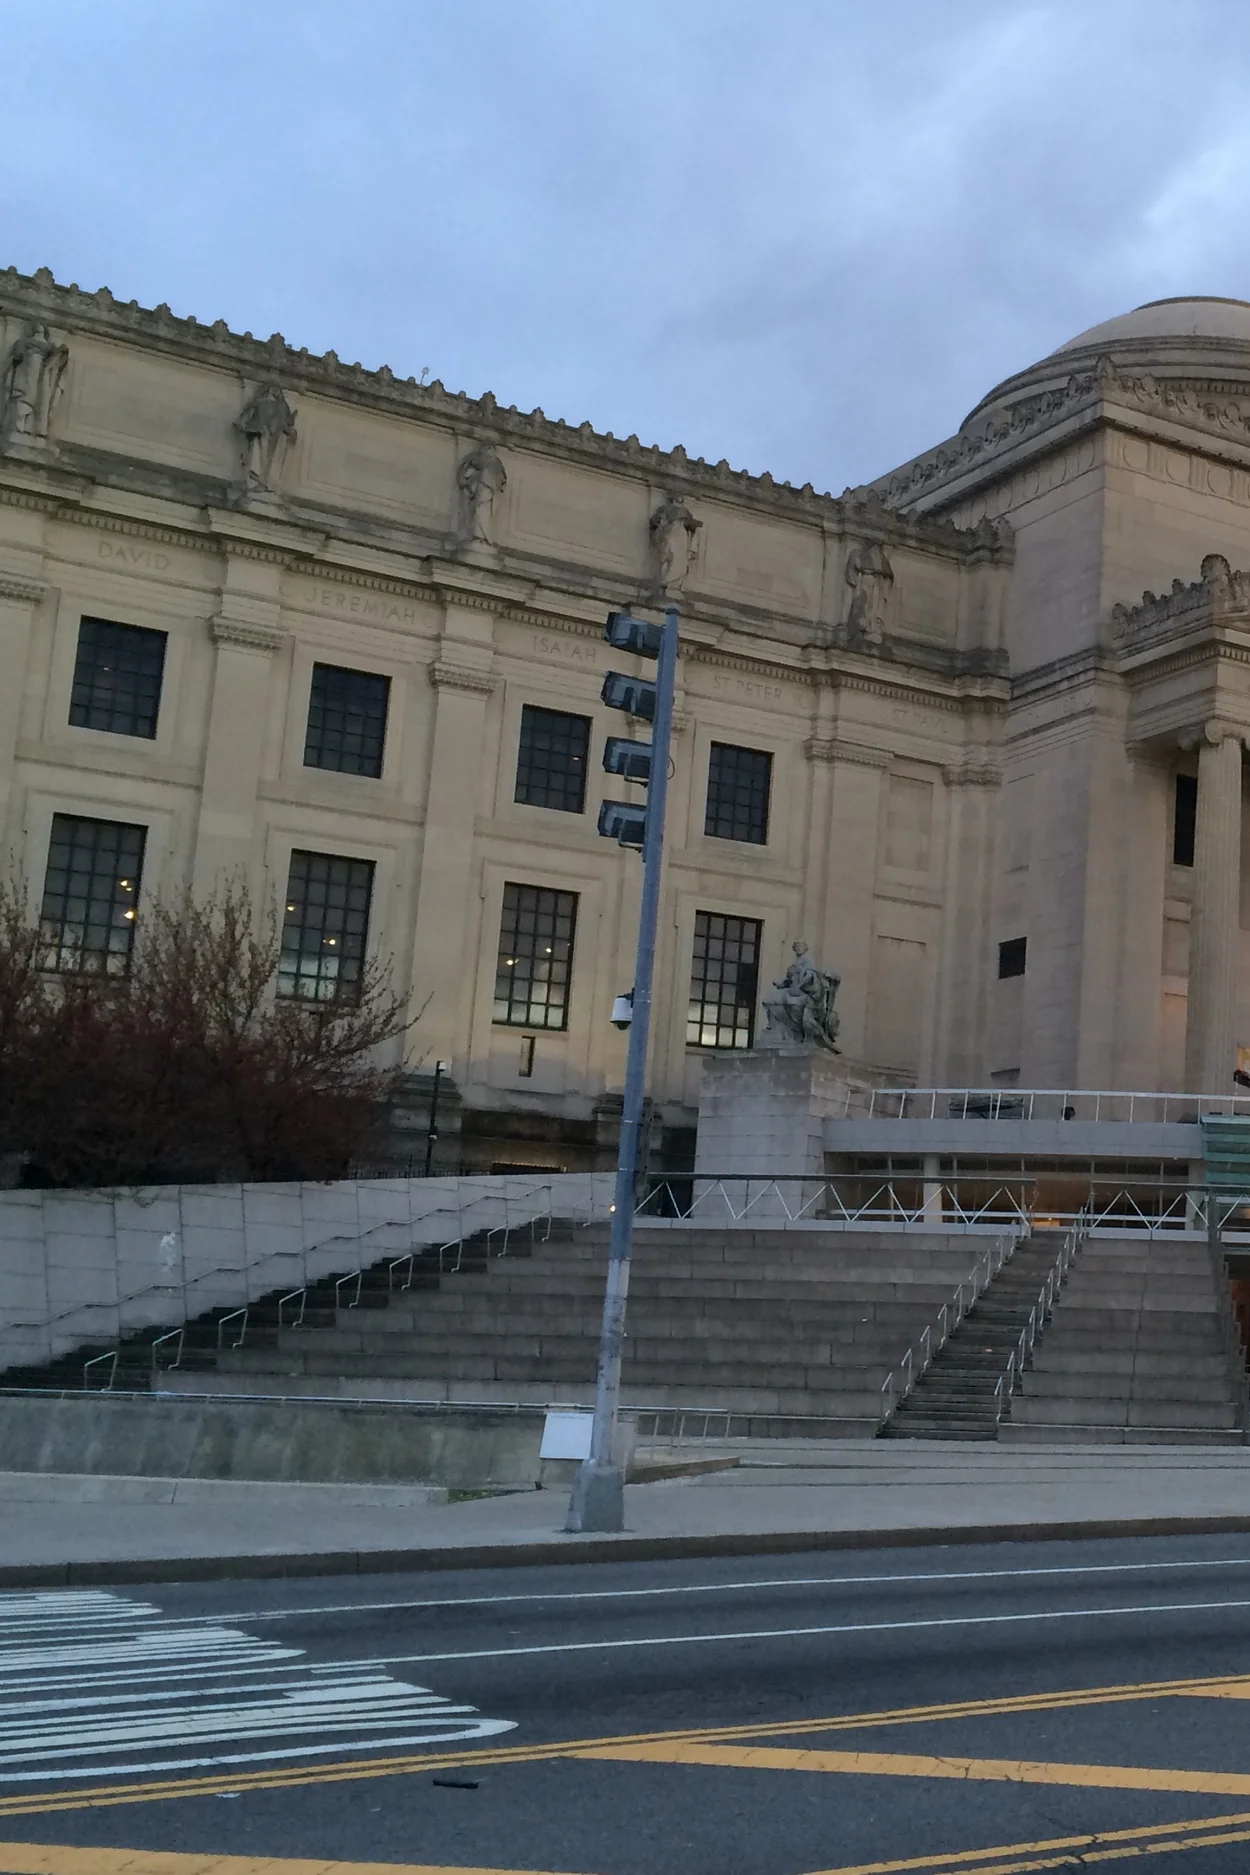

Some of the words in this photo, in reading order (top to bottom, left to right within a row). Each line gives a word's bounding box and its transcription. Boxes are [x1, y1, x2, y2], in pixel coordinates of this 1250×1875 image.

[97, 540, 171, 570] DAVID
[305, 587, 414, 625] JEREMIAH
[533, 635, 596, 663] ISAIAH
[737, 680, 783, 702] PETER
